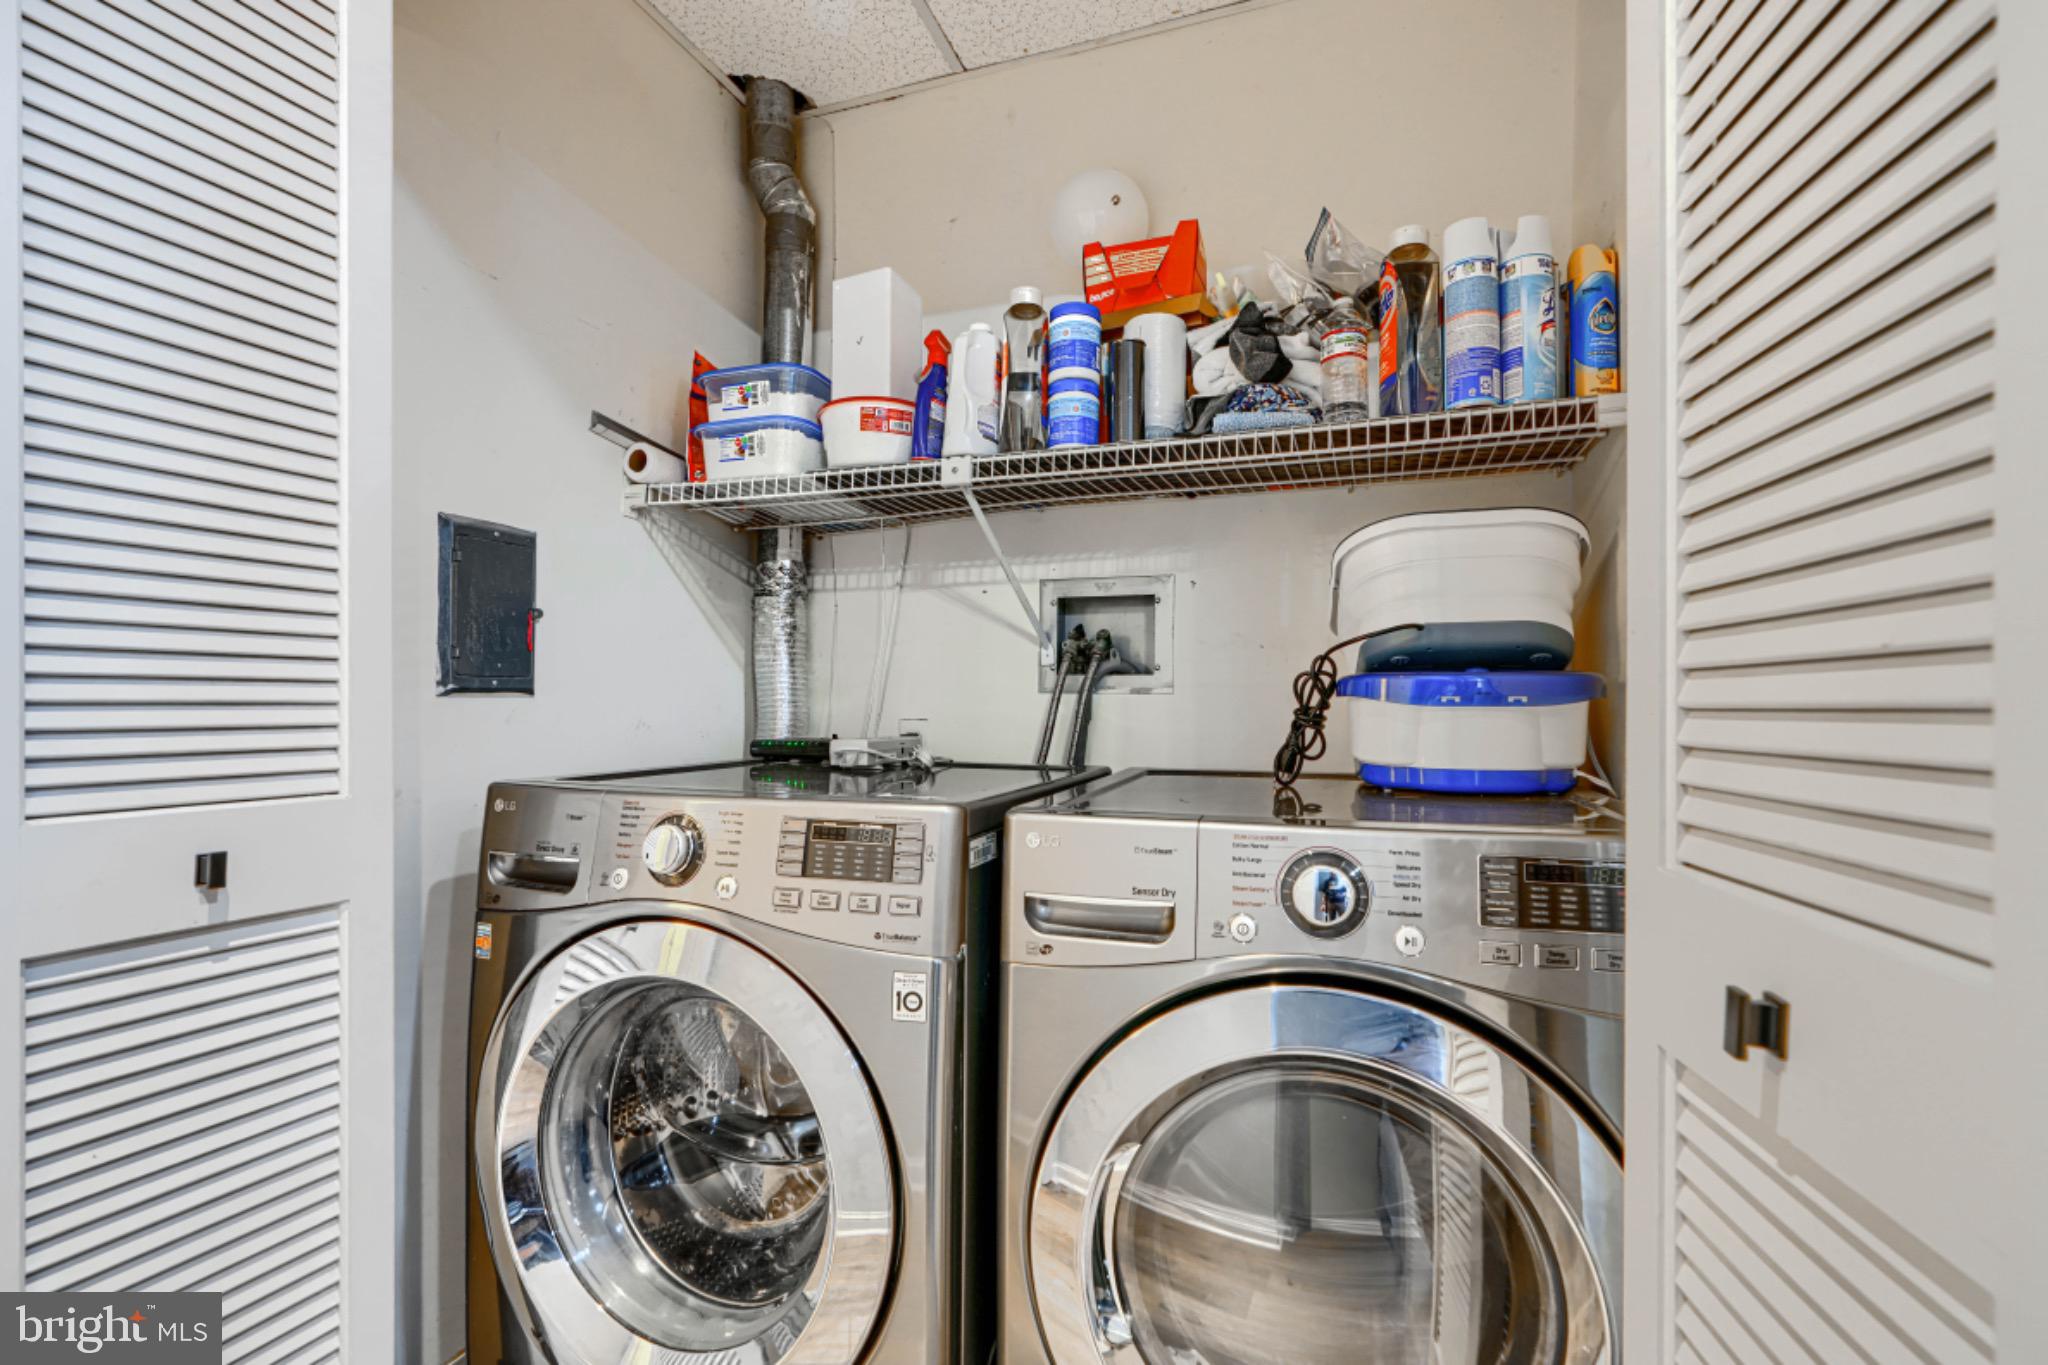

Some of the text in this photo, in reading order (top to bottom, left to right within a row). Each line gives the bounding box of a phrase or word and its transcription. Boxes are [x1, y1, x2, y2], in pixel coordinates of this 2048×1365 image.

[1131, 886, 1176, 898] Sensor Dry
[896, 990, 923, 1013] 10
